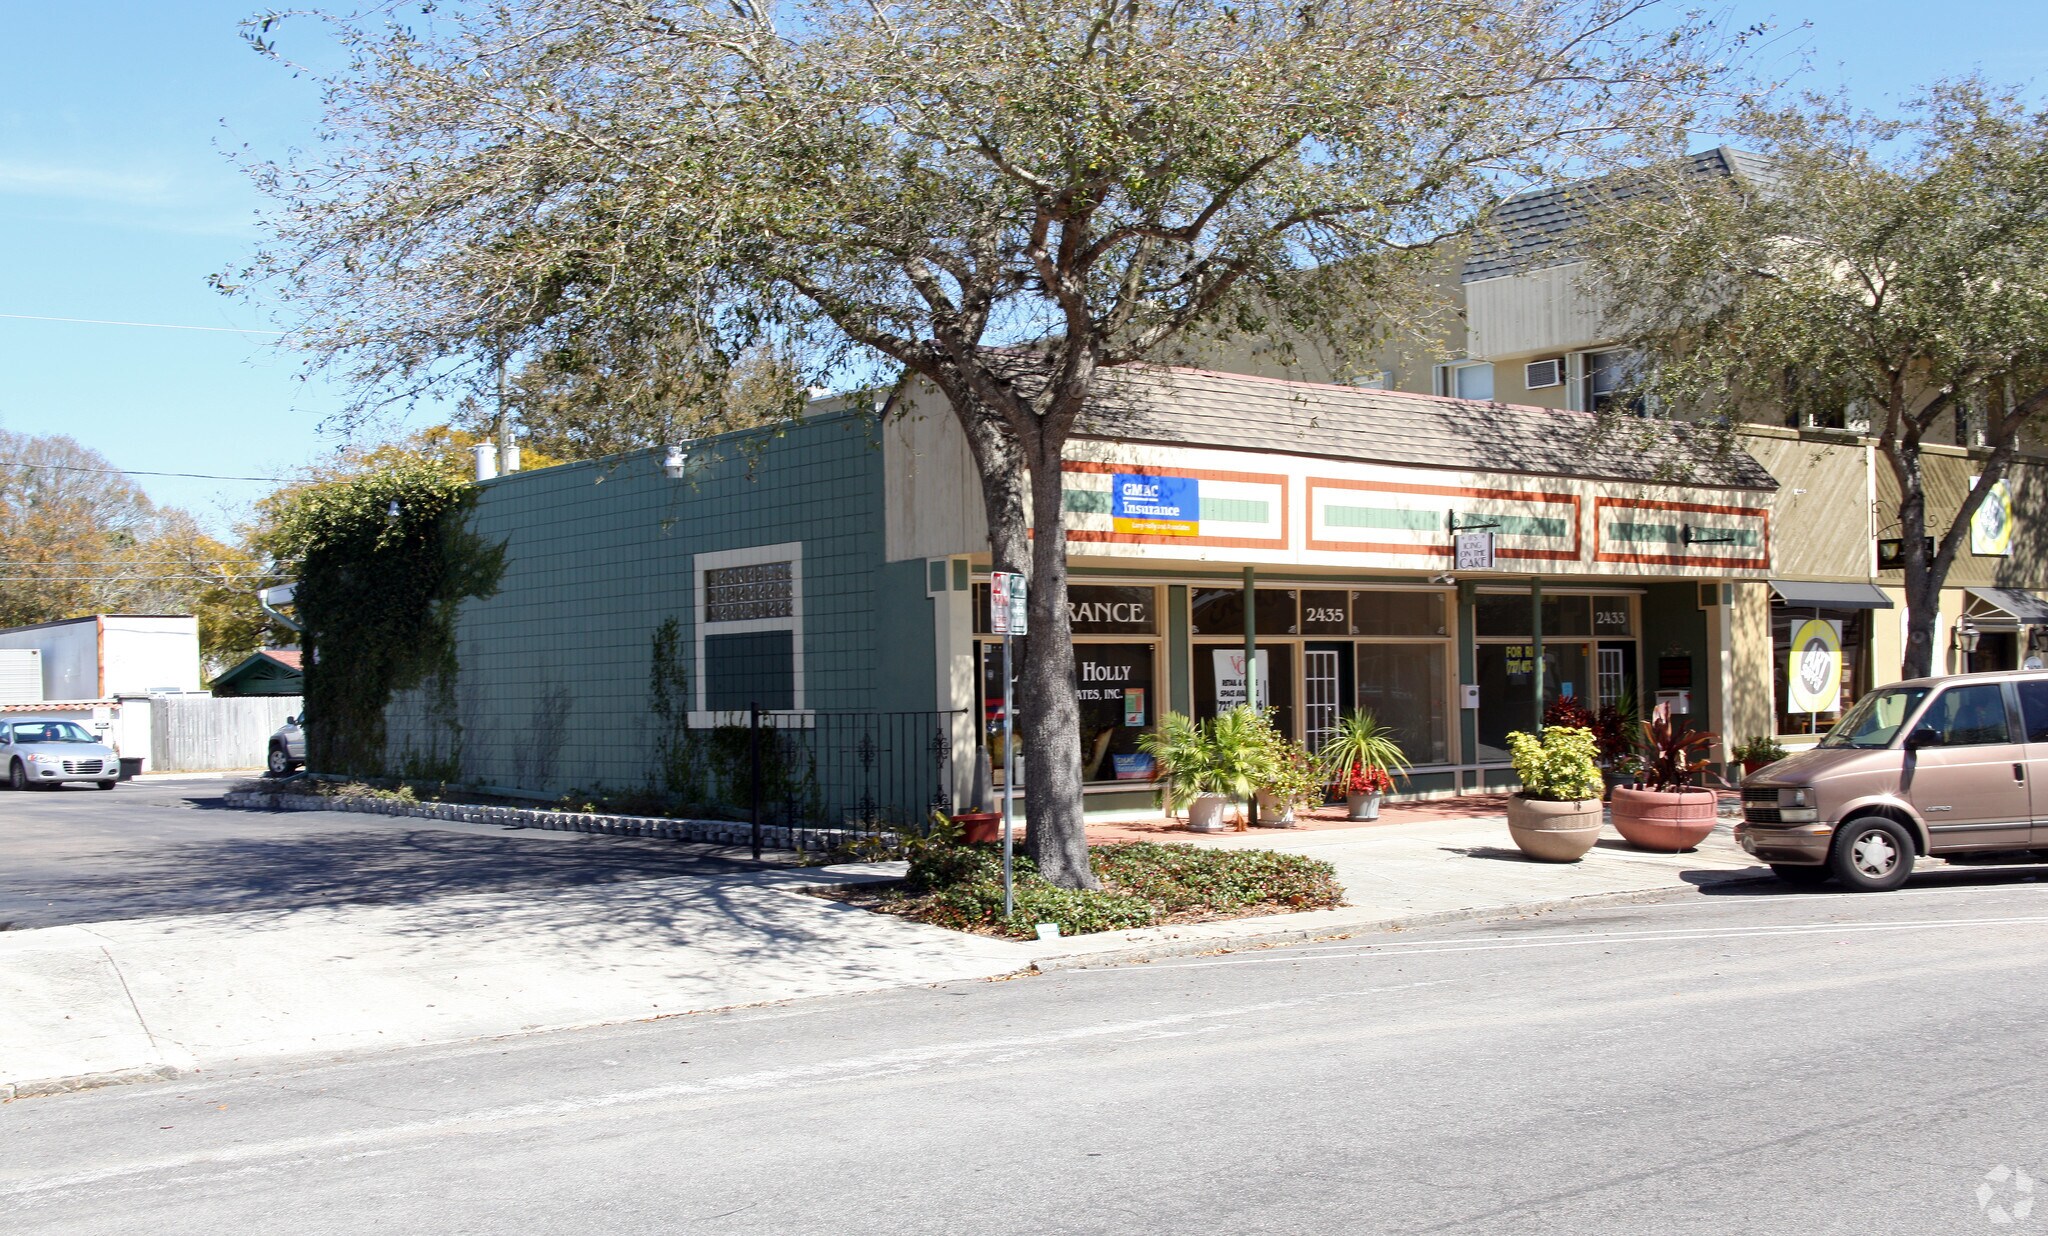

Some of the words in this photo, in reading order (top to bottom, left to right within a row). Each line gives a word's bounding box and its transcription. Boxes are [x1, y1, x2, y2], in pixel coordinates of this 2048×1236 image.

[1122, 483, 1159, 497] GMAC
[1122, 501, 1180, 517] Insurance
[1473, 549, 1486, 557] THE
[1459, 556, 1487, 569] CAKE
[1306, 607, 1344, 622] 2435
[1595, 611, 1626, 624] 2433
[1505, 646, 1522, 658] FOR
[1104, 688, 1124, 699] INC.
